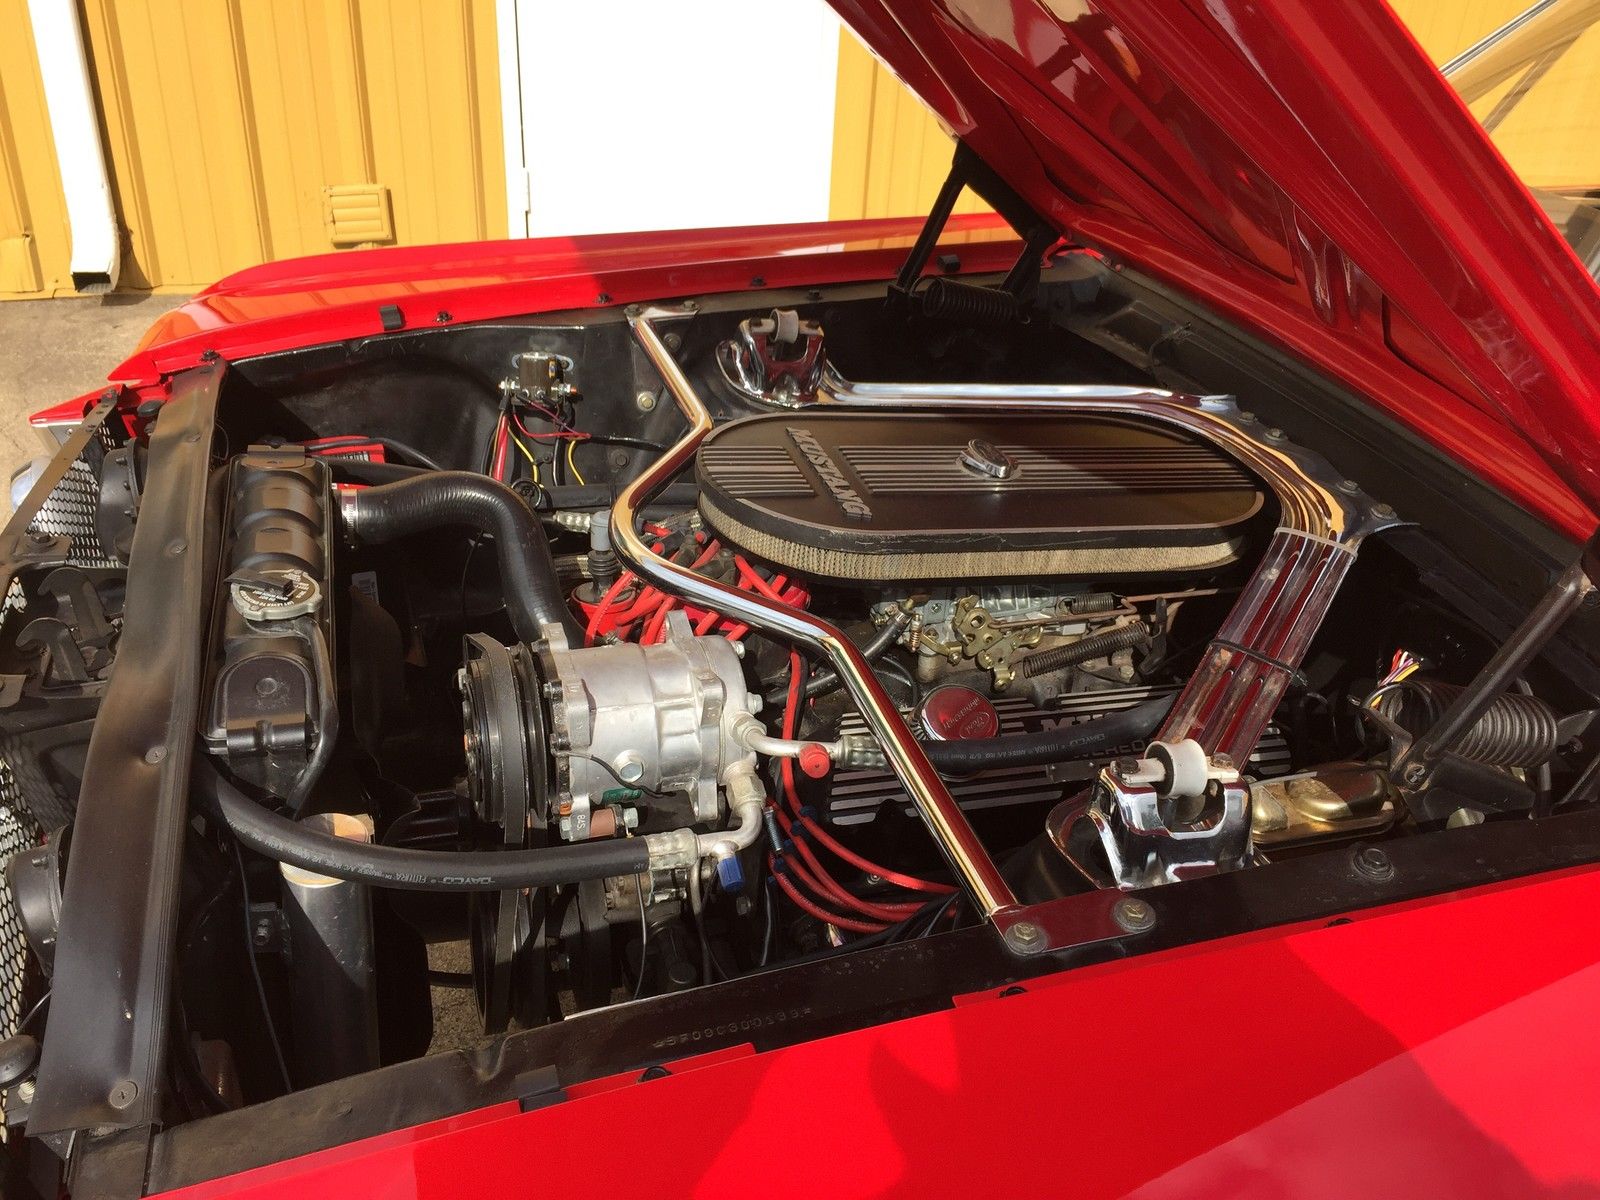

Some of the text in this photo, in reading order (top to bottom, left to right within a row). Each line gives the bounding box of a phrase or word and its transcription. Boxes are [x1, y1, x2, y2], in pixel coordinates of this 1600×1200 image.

[786, 426, 872, 520] MUSTANG
[396, 872, 426, 883] FUTURA
[443, 876, 495, 885] DAYCO
